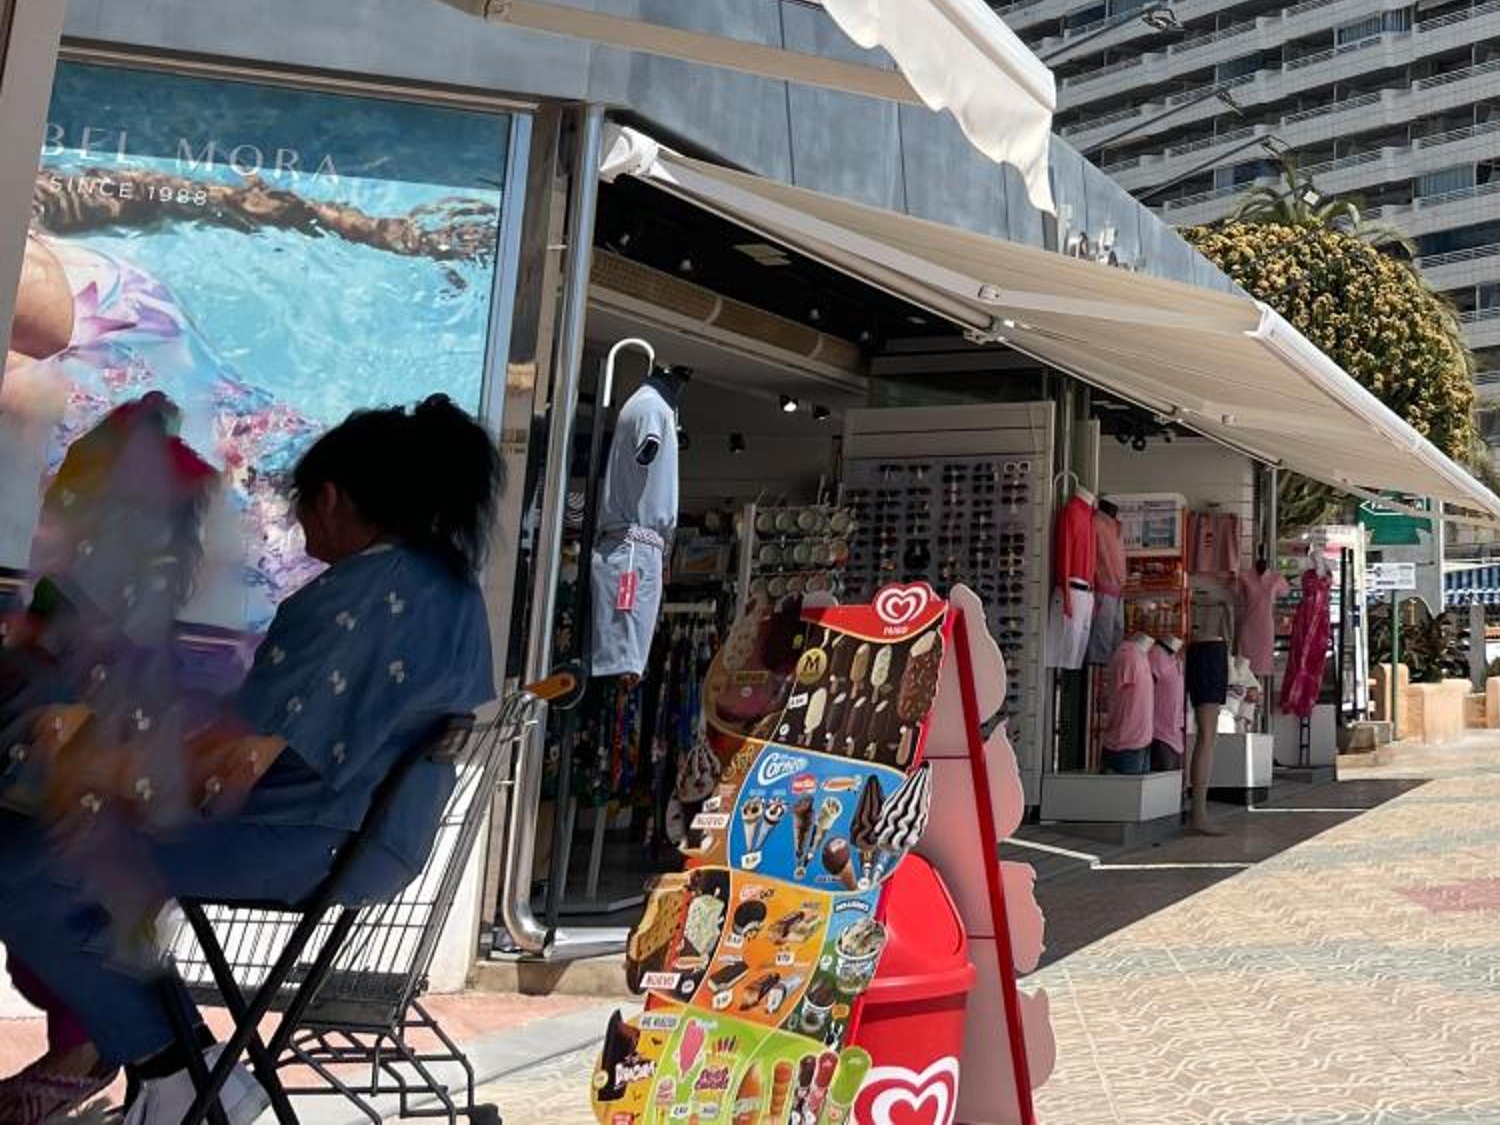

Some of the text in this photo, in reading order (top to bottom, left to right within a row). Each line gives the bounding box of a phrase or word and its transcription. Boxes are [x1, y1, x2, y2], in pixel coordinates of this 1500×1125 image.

[176, 137, 340, 185] MORA
[49, 176, 208, 207] SINCE 1988
